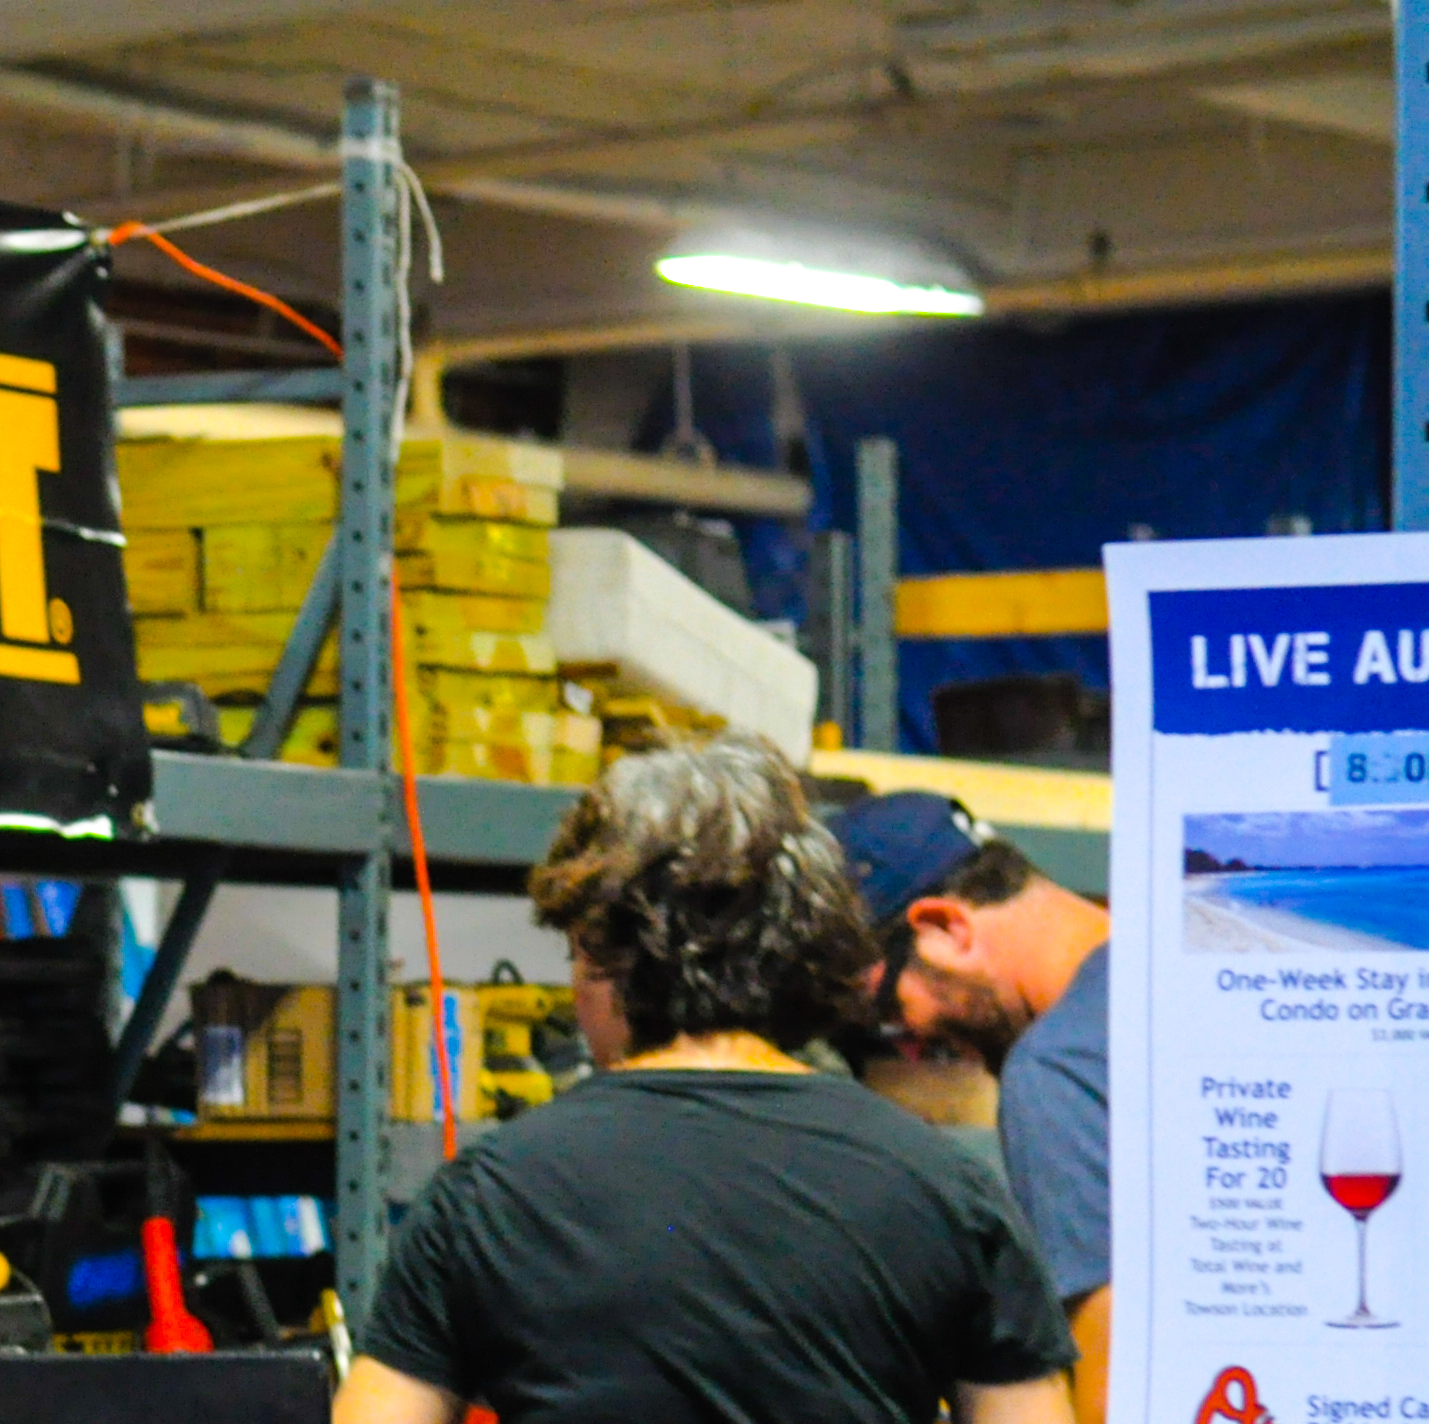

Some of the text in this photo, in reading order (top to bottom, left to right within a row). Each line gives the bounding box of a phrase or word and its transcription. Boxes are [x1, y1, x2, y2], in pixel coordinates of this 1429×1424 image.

[1191, 631, 1331, 689] LIVE
[1217, 968, 1347, 992] One-Week
[1356, 966, 1409, 995] Stay
[1260, 998, 1340, 1021] Condo
[1347, 1003, 1379, 1021] on
[1201, 1076, 1292, 1099] Private
[1214, 1106, 1279, 1129] Wine
[1201, 1136, 1292, 1165] Tasting
[1205, 1166, 1288, 1189] For 20
[1306, 1395, 1390, 1423] Signed
